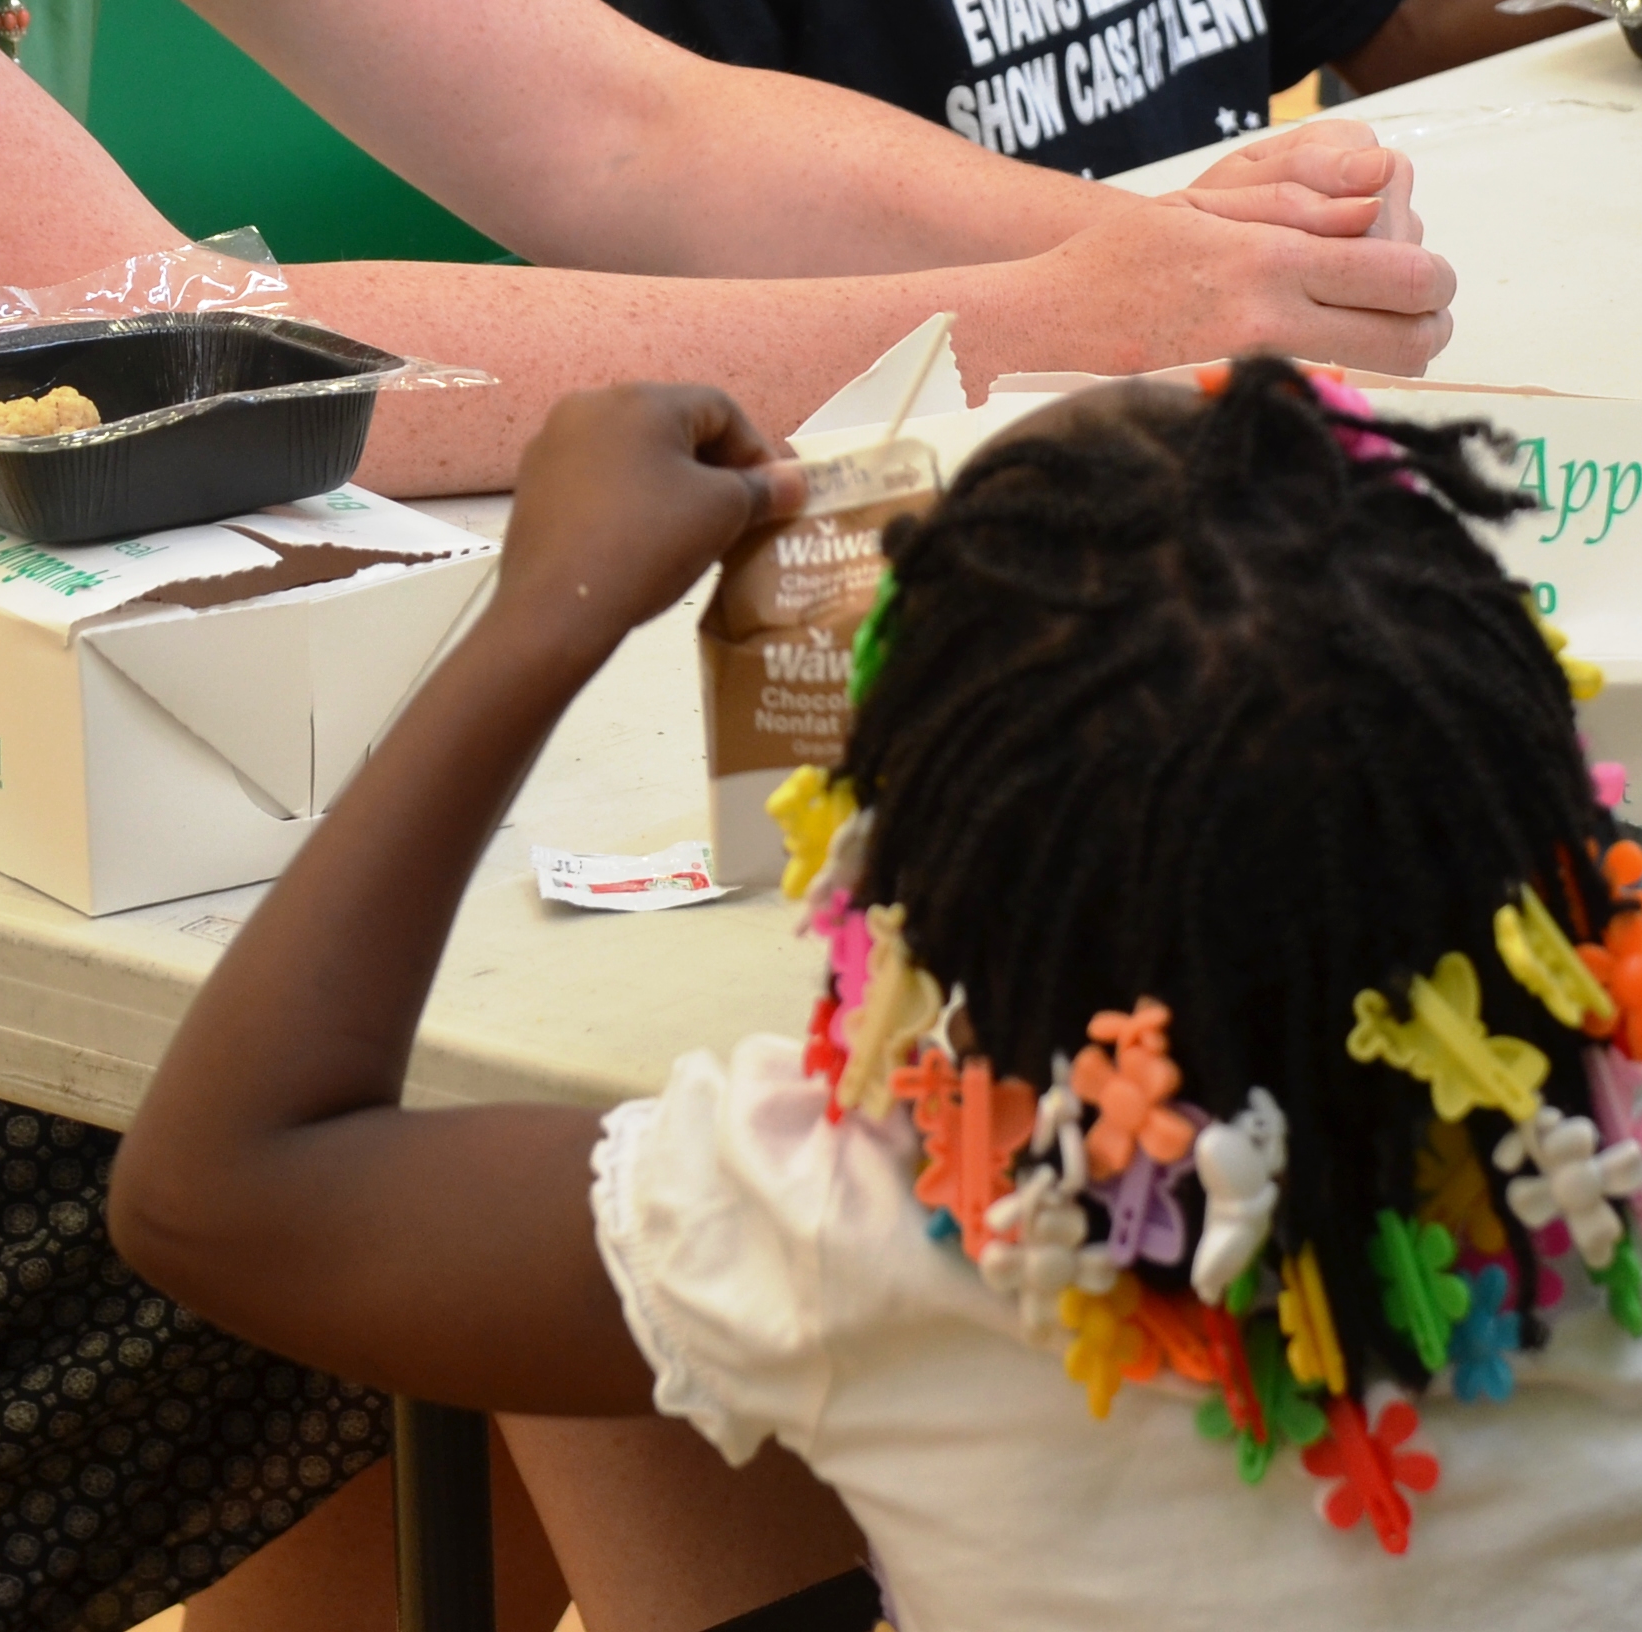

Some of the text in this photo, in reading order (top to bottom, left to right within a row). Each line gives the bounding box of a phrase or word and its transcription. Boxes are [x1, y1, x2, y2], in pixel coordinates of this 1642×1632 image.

[945, 52, 1067, 155] SHOW
[1065, 18, 1147, 125] CASE
[764, 643, 854, 684] Waw
[761, 686, 850, 710] Choco
